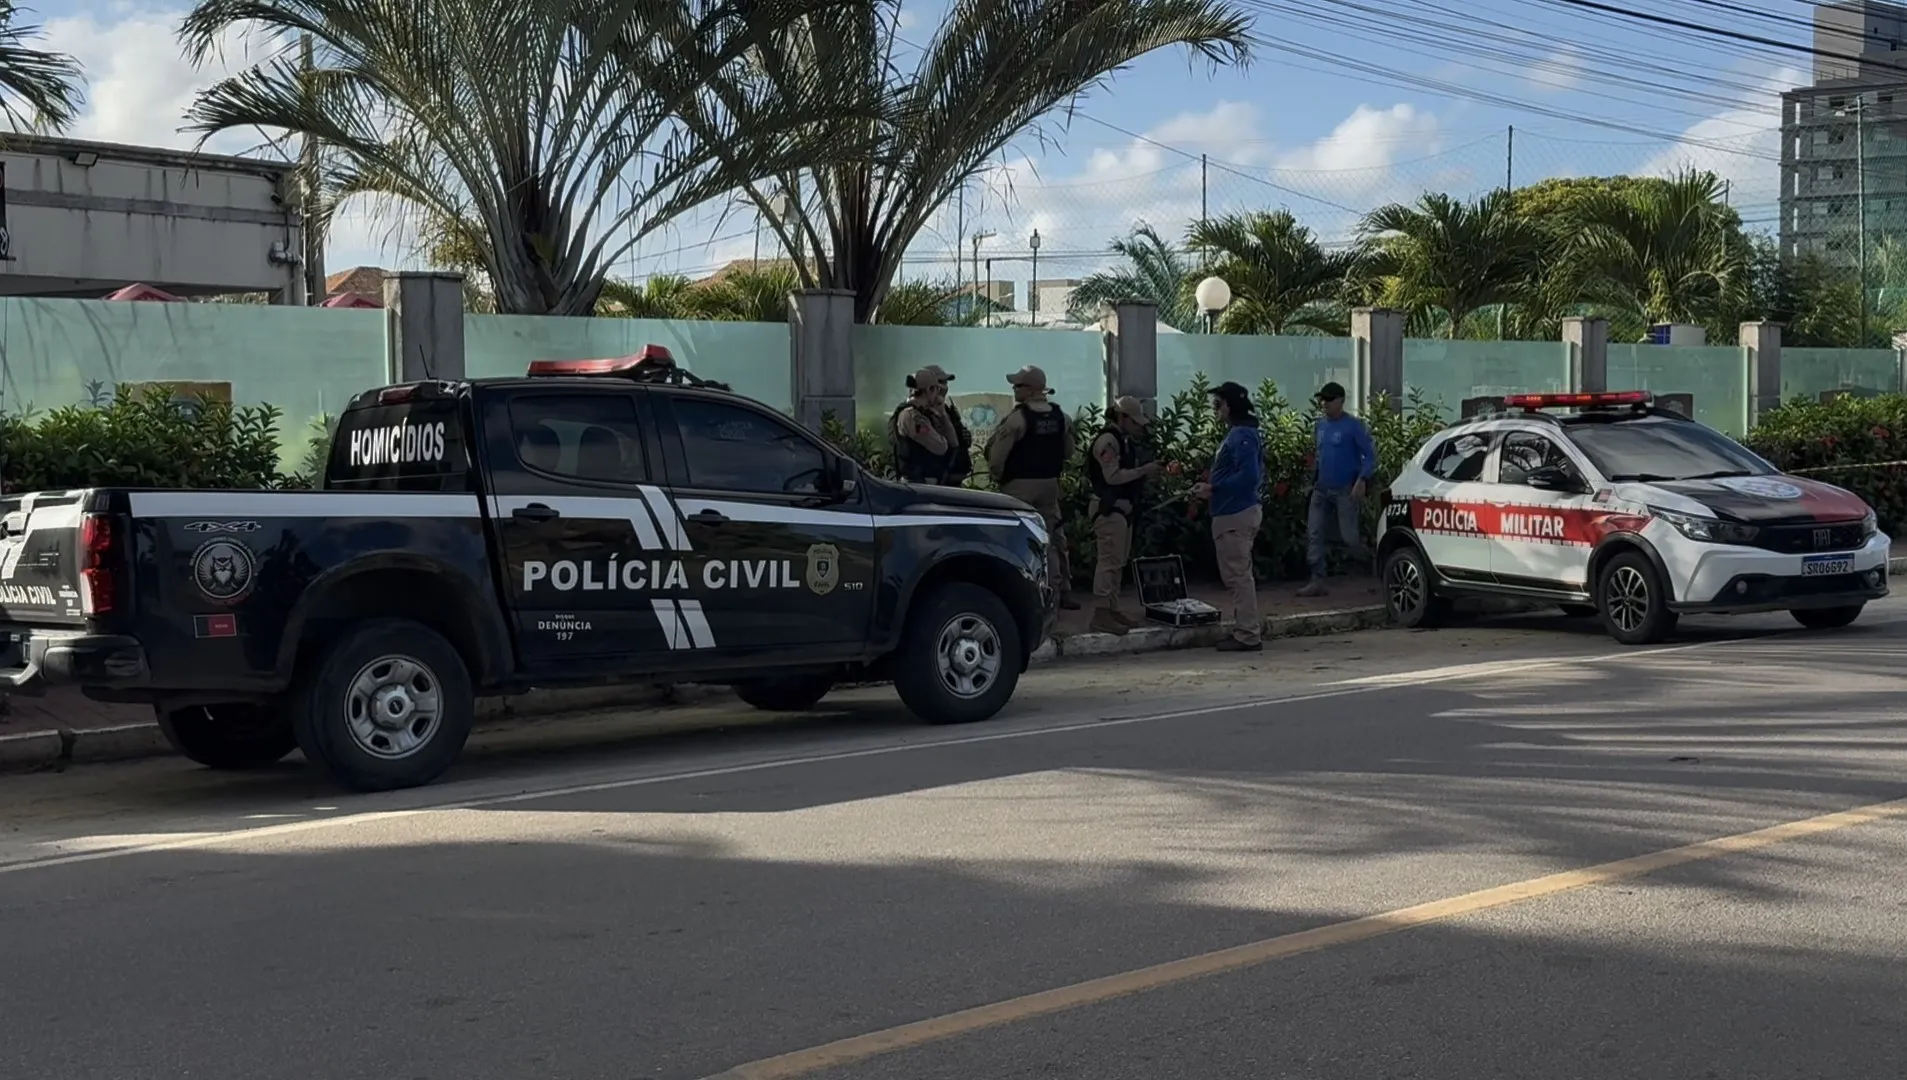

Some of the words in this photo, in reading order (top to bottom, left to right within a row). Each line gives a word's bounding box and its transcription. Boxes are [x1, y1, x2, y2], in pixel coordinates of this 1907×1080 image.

[351, 416, 445, 466] HOMICÍDIOS
[1423, 505, 1478, 532] POLÍCIA
[1500, 512, 1564, 537] MILITAR
[1813, 528, 1831, 546] FIAT
[523, 552, 689, 591] POLÍCIA
[702, 559, 800, 589] CIVIL
[27, 585, 56, 605] CIVIL
[844, 582, 863, 591] S10
[556, 632, 574, 641] 197
